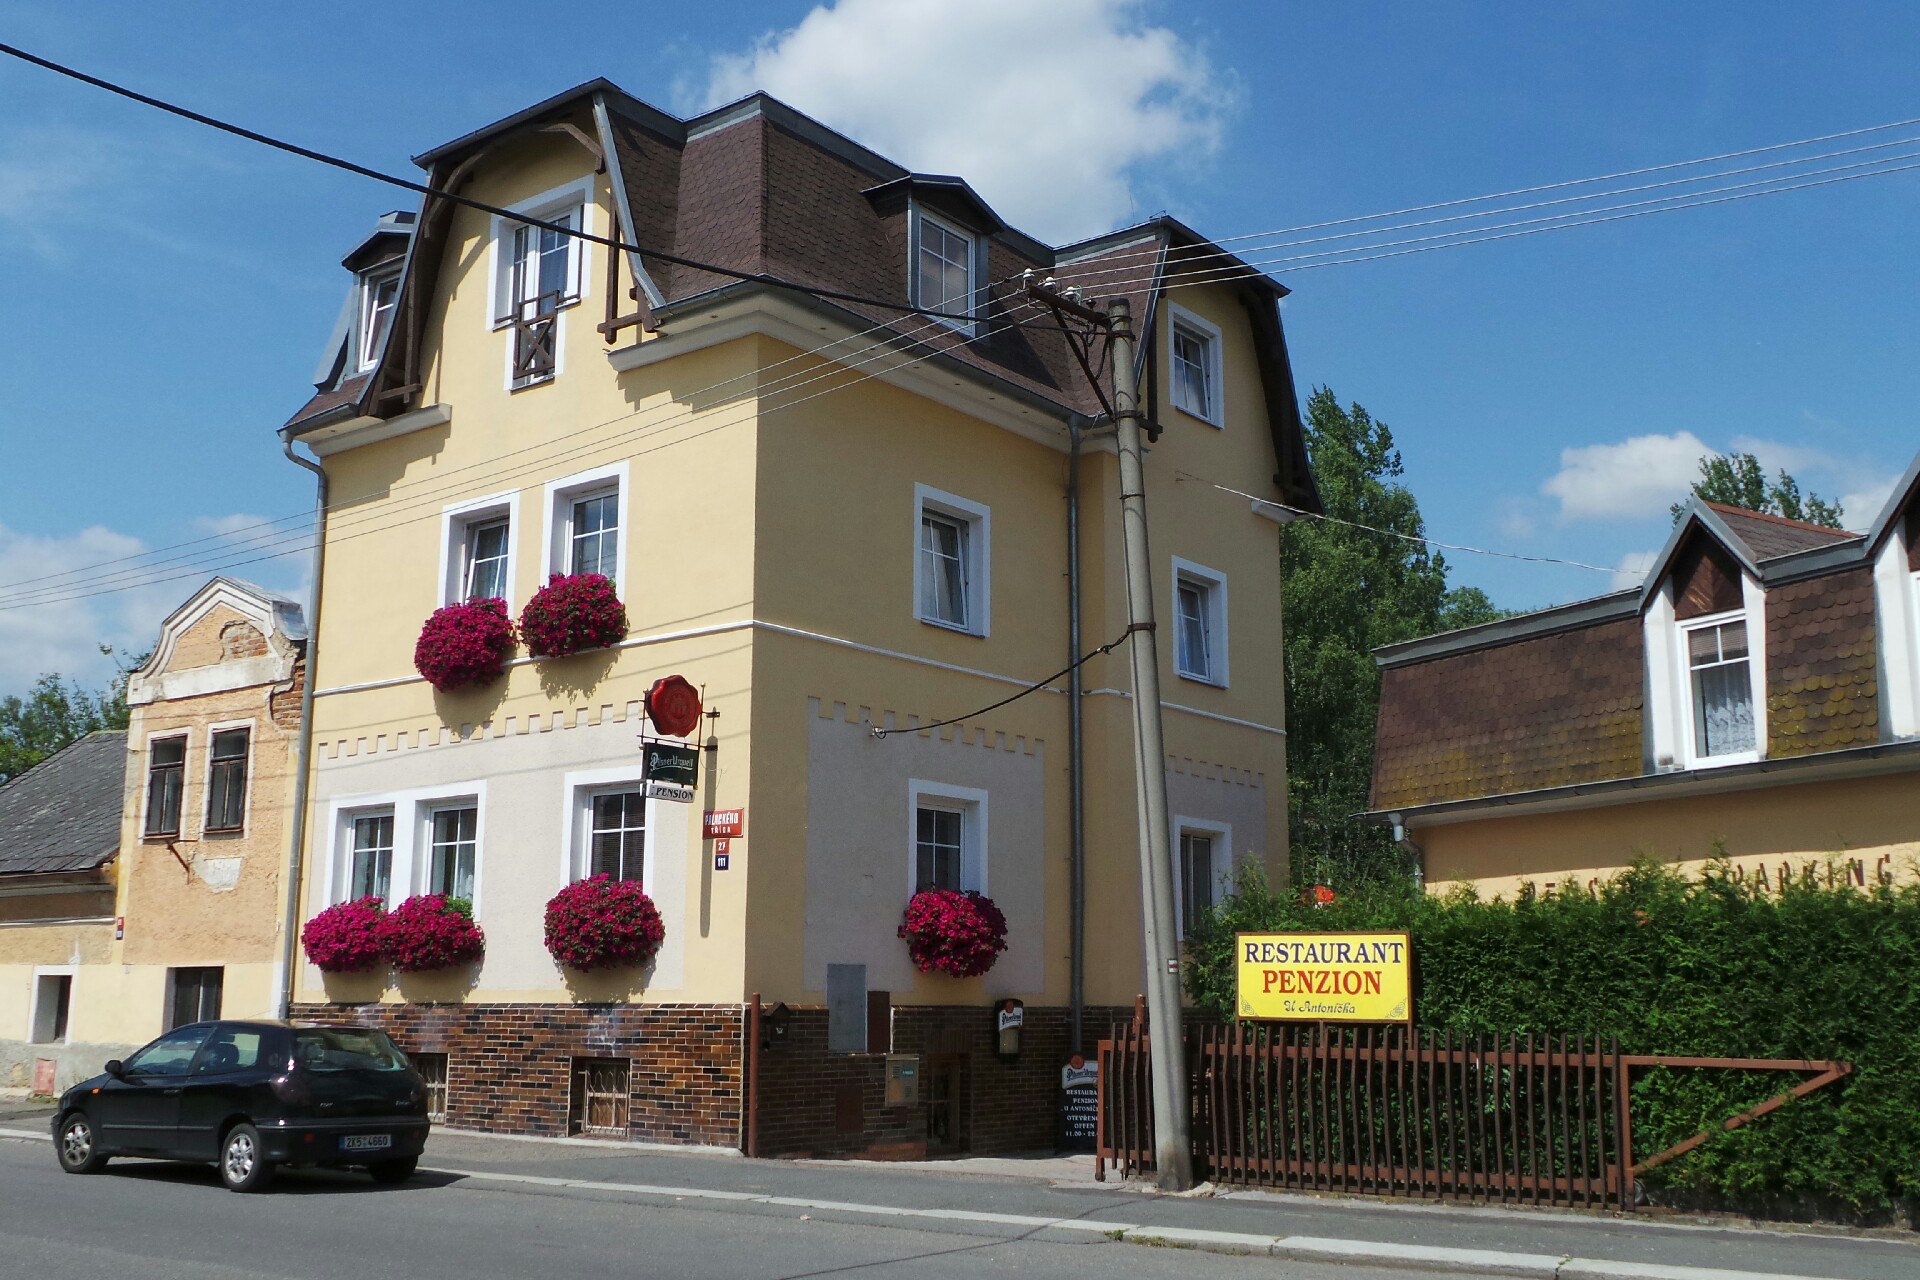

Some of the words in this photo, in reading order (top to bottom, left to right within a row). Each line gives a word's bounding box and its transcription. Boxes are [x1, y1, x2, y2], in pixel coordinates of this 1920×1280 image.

[650, 752, 672, 771] Pilsner
[656, 787, 694, 800] PENSION
[705, 811, 739, 825] PALACKÉHO
[718, 841, 726, 851] 27
[717, 857, 726, 867] 111
[1245, 942, 1404, 963] RESTAURANT
[1262, 970, 1382, 995] PENZION
[1299, 1002, 1356, 1014] Antoníčka
